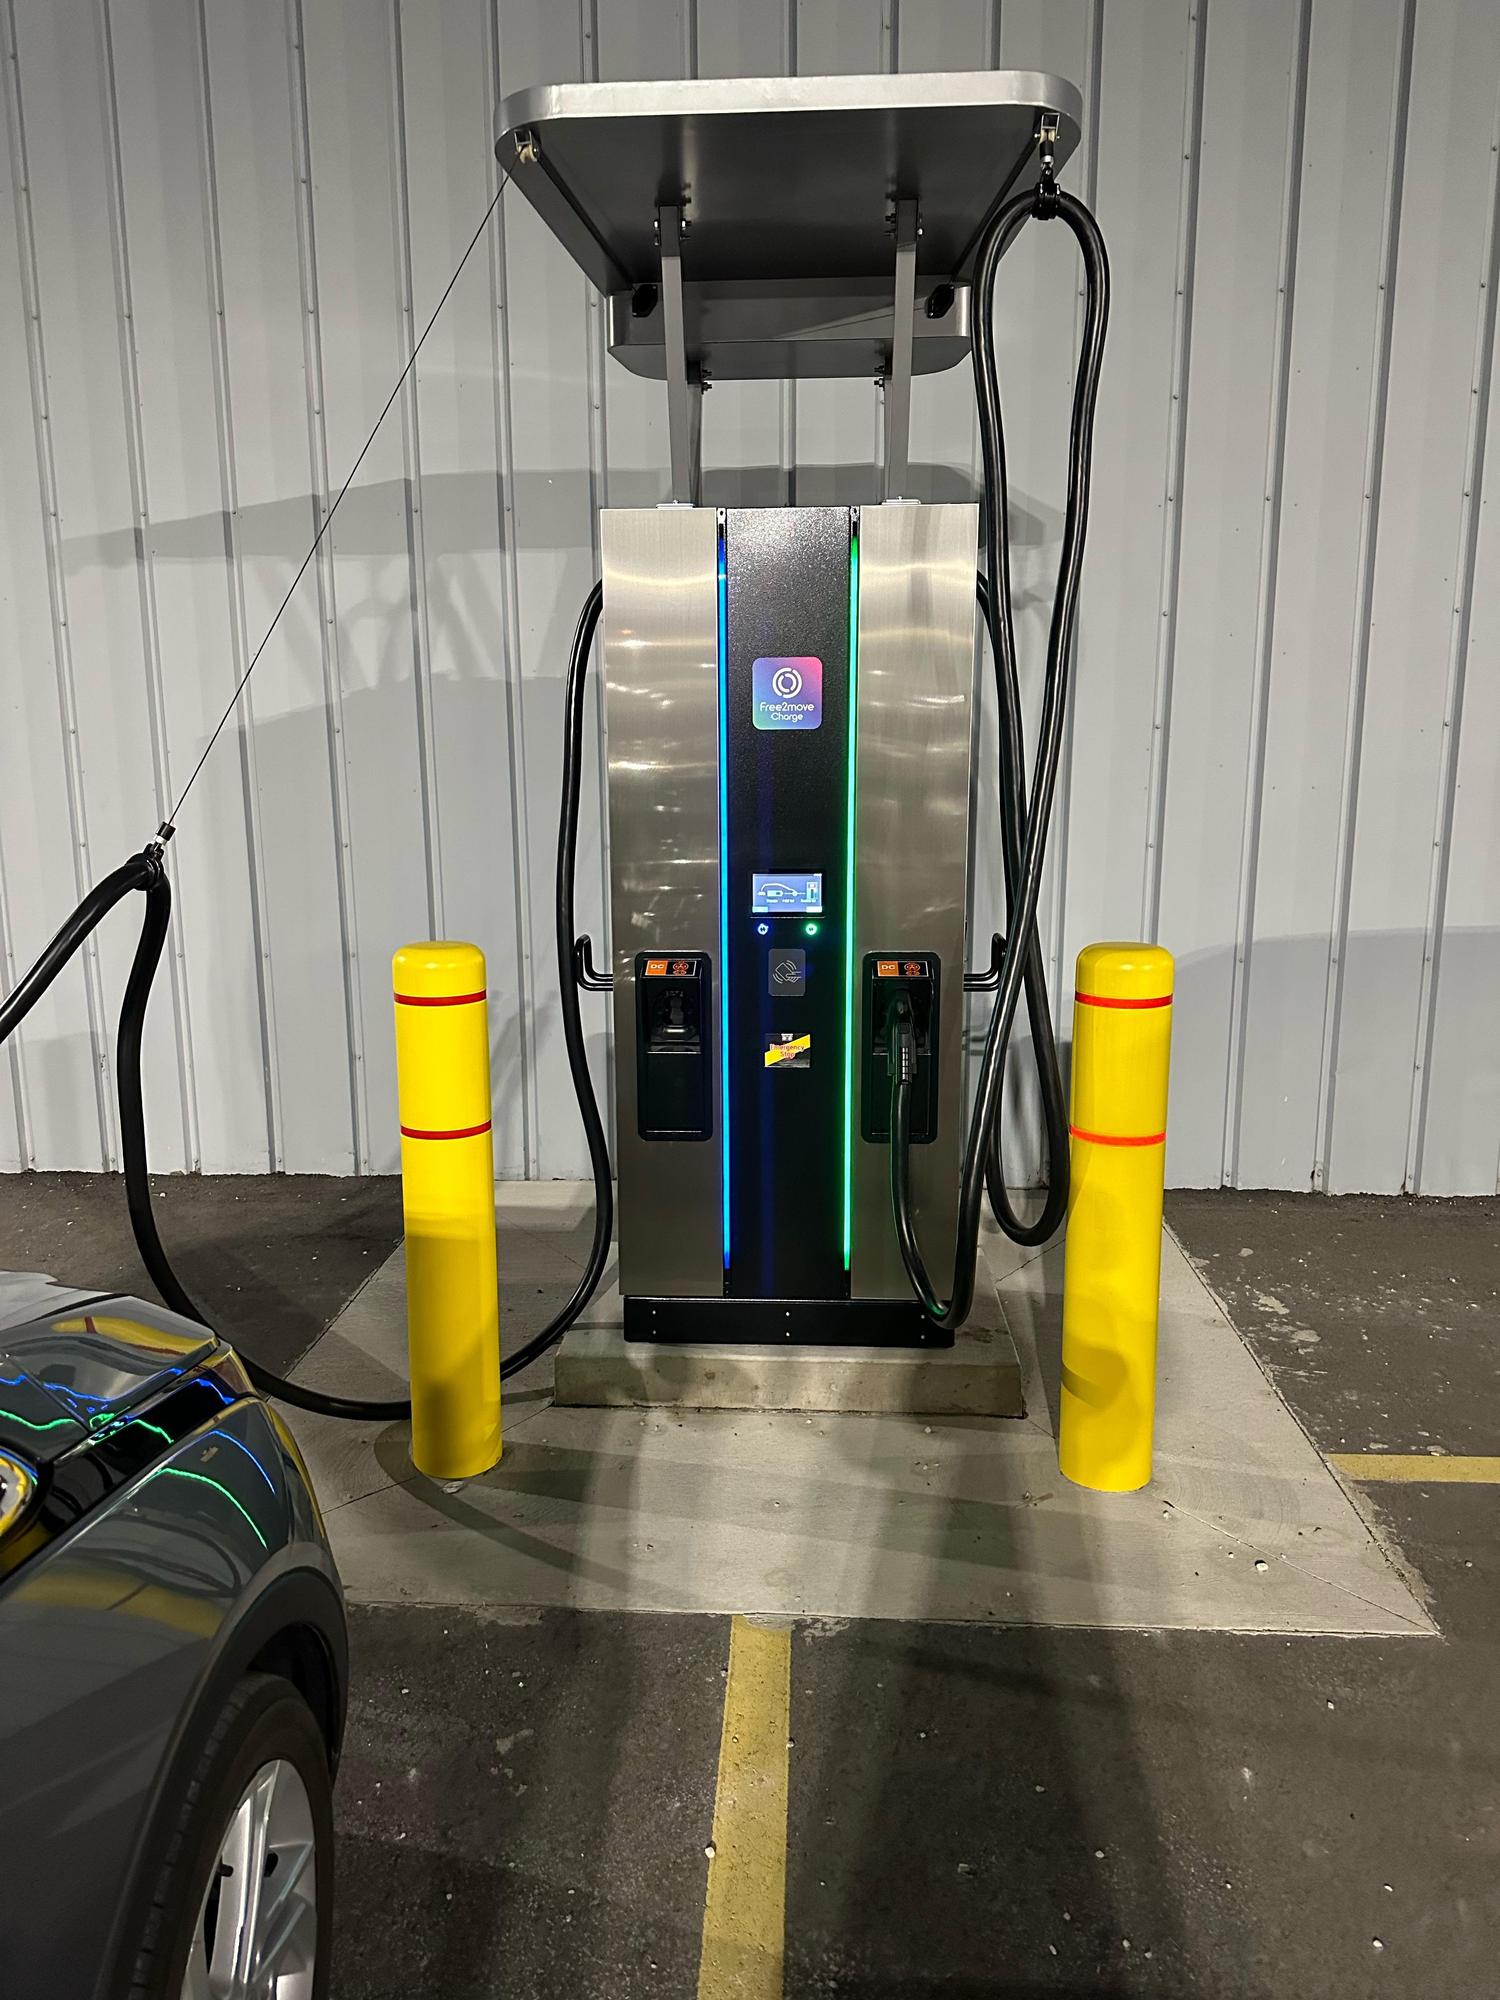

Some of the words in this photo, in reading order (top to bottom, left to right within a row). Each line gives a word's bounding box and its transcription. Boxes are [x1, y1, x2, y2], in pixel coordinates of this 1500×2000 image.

[760, 702, 815, 711] Free2move
[771, 712, 803, 723] Charge
[770, 1044, 805, 1052] Emergency
[780, 1051, 796, 1059] Stop
